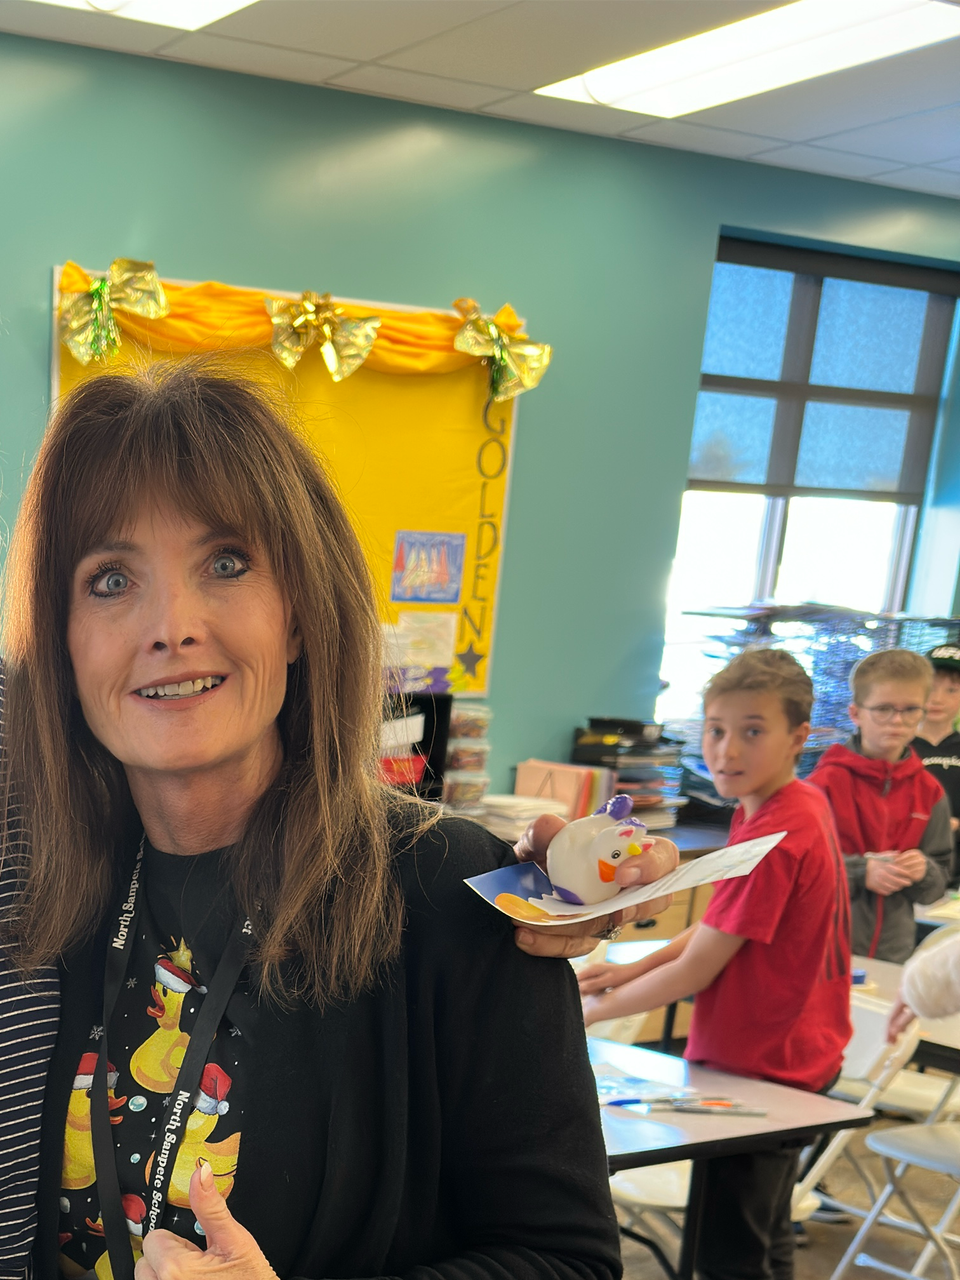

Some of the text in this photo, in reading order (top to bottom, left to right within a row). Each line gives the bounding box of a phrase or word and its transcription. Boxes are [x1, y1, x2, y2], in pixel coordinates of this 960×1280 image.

[459, 395, 507, 643] GOLDEN
[111, 909, 136, 950] North
[148, 1089, 191, 1233] North Sanpete Schoo
